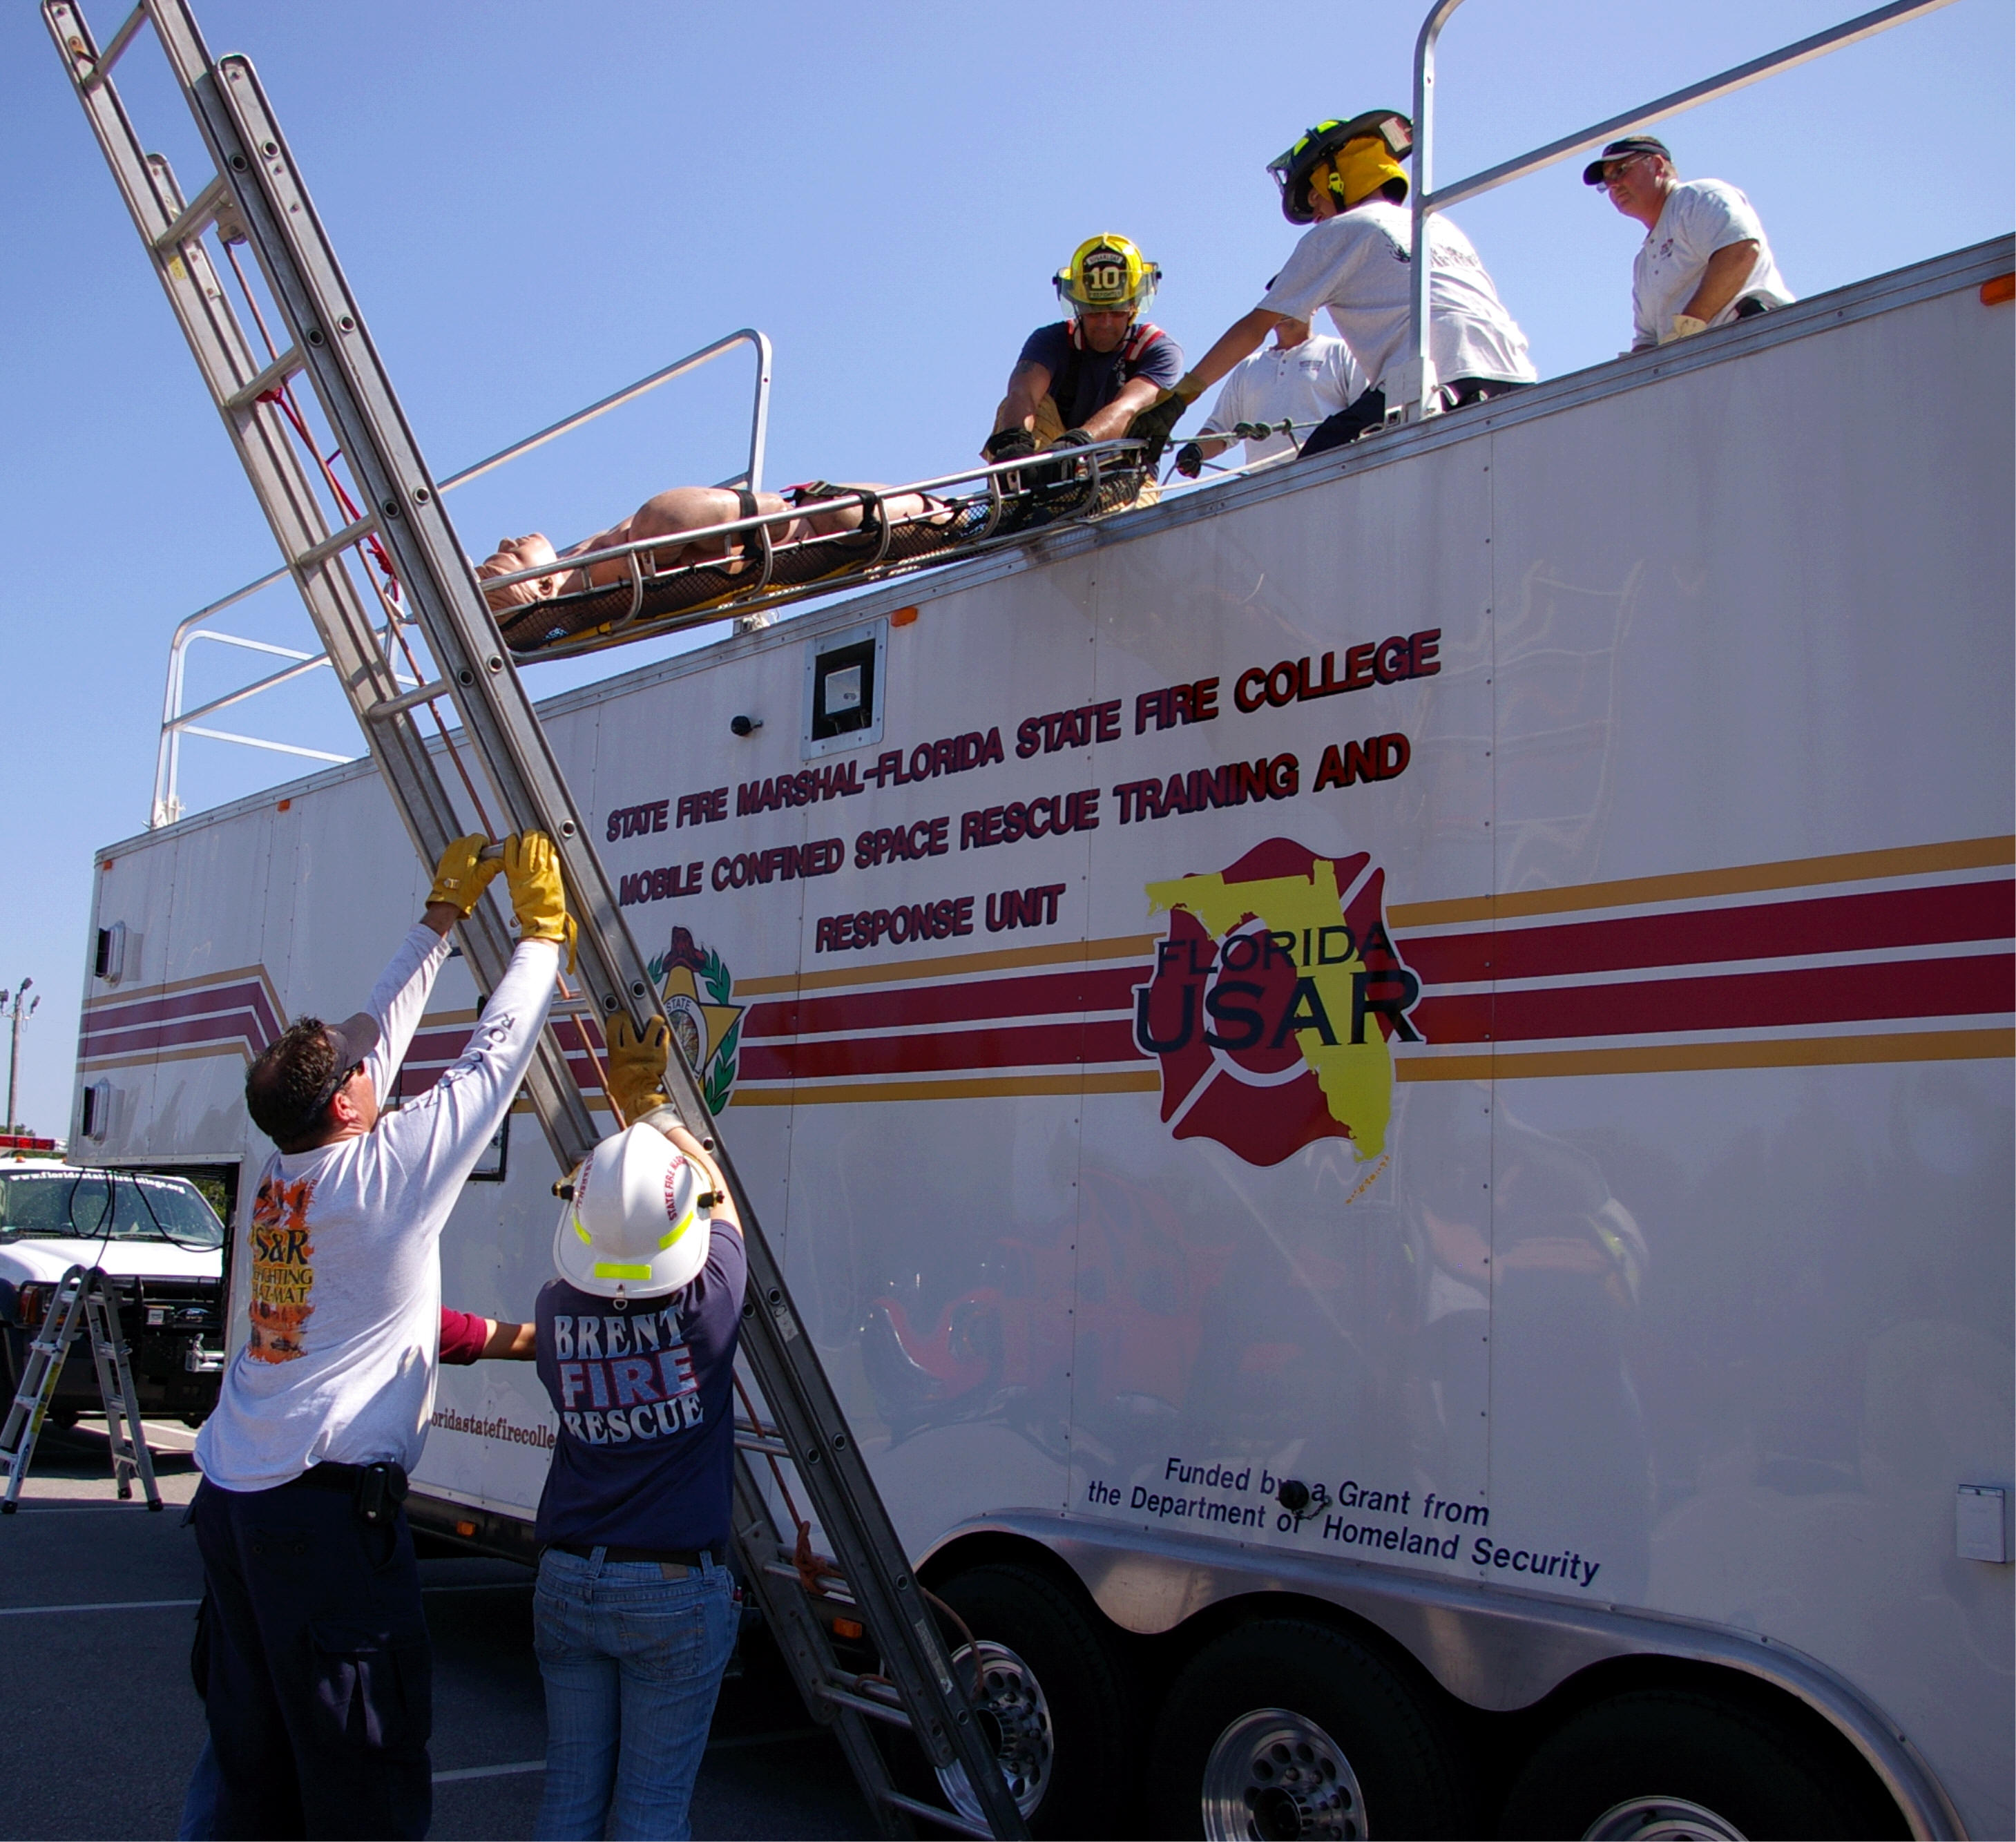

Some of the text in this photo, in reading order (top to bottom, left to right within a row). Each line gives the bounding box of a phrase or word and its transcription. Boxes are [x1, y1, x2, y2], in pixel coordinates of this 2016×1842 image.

[1091, 267, 1120, 289] 10
[606, 628, 1441, 842] STATE FIRE MARSHAL-FLORIDA STATE FIRE COLLEGE
[619, 732, 1411, 905] MOBILE CONFINED SPACE RESCUE TRAINING AND
[815, 883, 1066, 953] RESPONSE UNIT
[1158, 922, 1399, 977] FLORIDA
[666, 997, 691, 1013] STATE
[1135, 969, 1424, 1053] USAR
[664, 1169, 675, 1189] FIRE
[665, 1191, 678, 1222] STATE
[554, 1305, 685, 1361] BRENT
[560, 1345, 700, 1410] FIRE
[563, 1394, 704, 1445] RESCUE
[1165, 1457, 1251, 1493] Funded
[1312, 1484, 1325, 1502] a
[1338, 1480, 1410, 1515] Grant
[1423, 1493, 1490, 1526] from
[1088, 1480, 1600, 1587] the Department of Homeland Security
